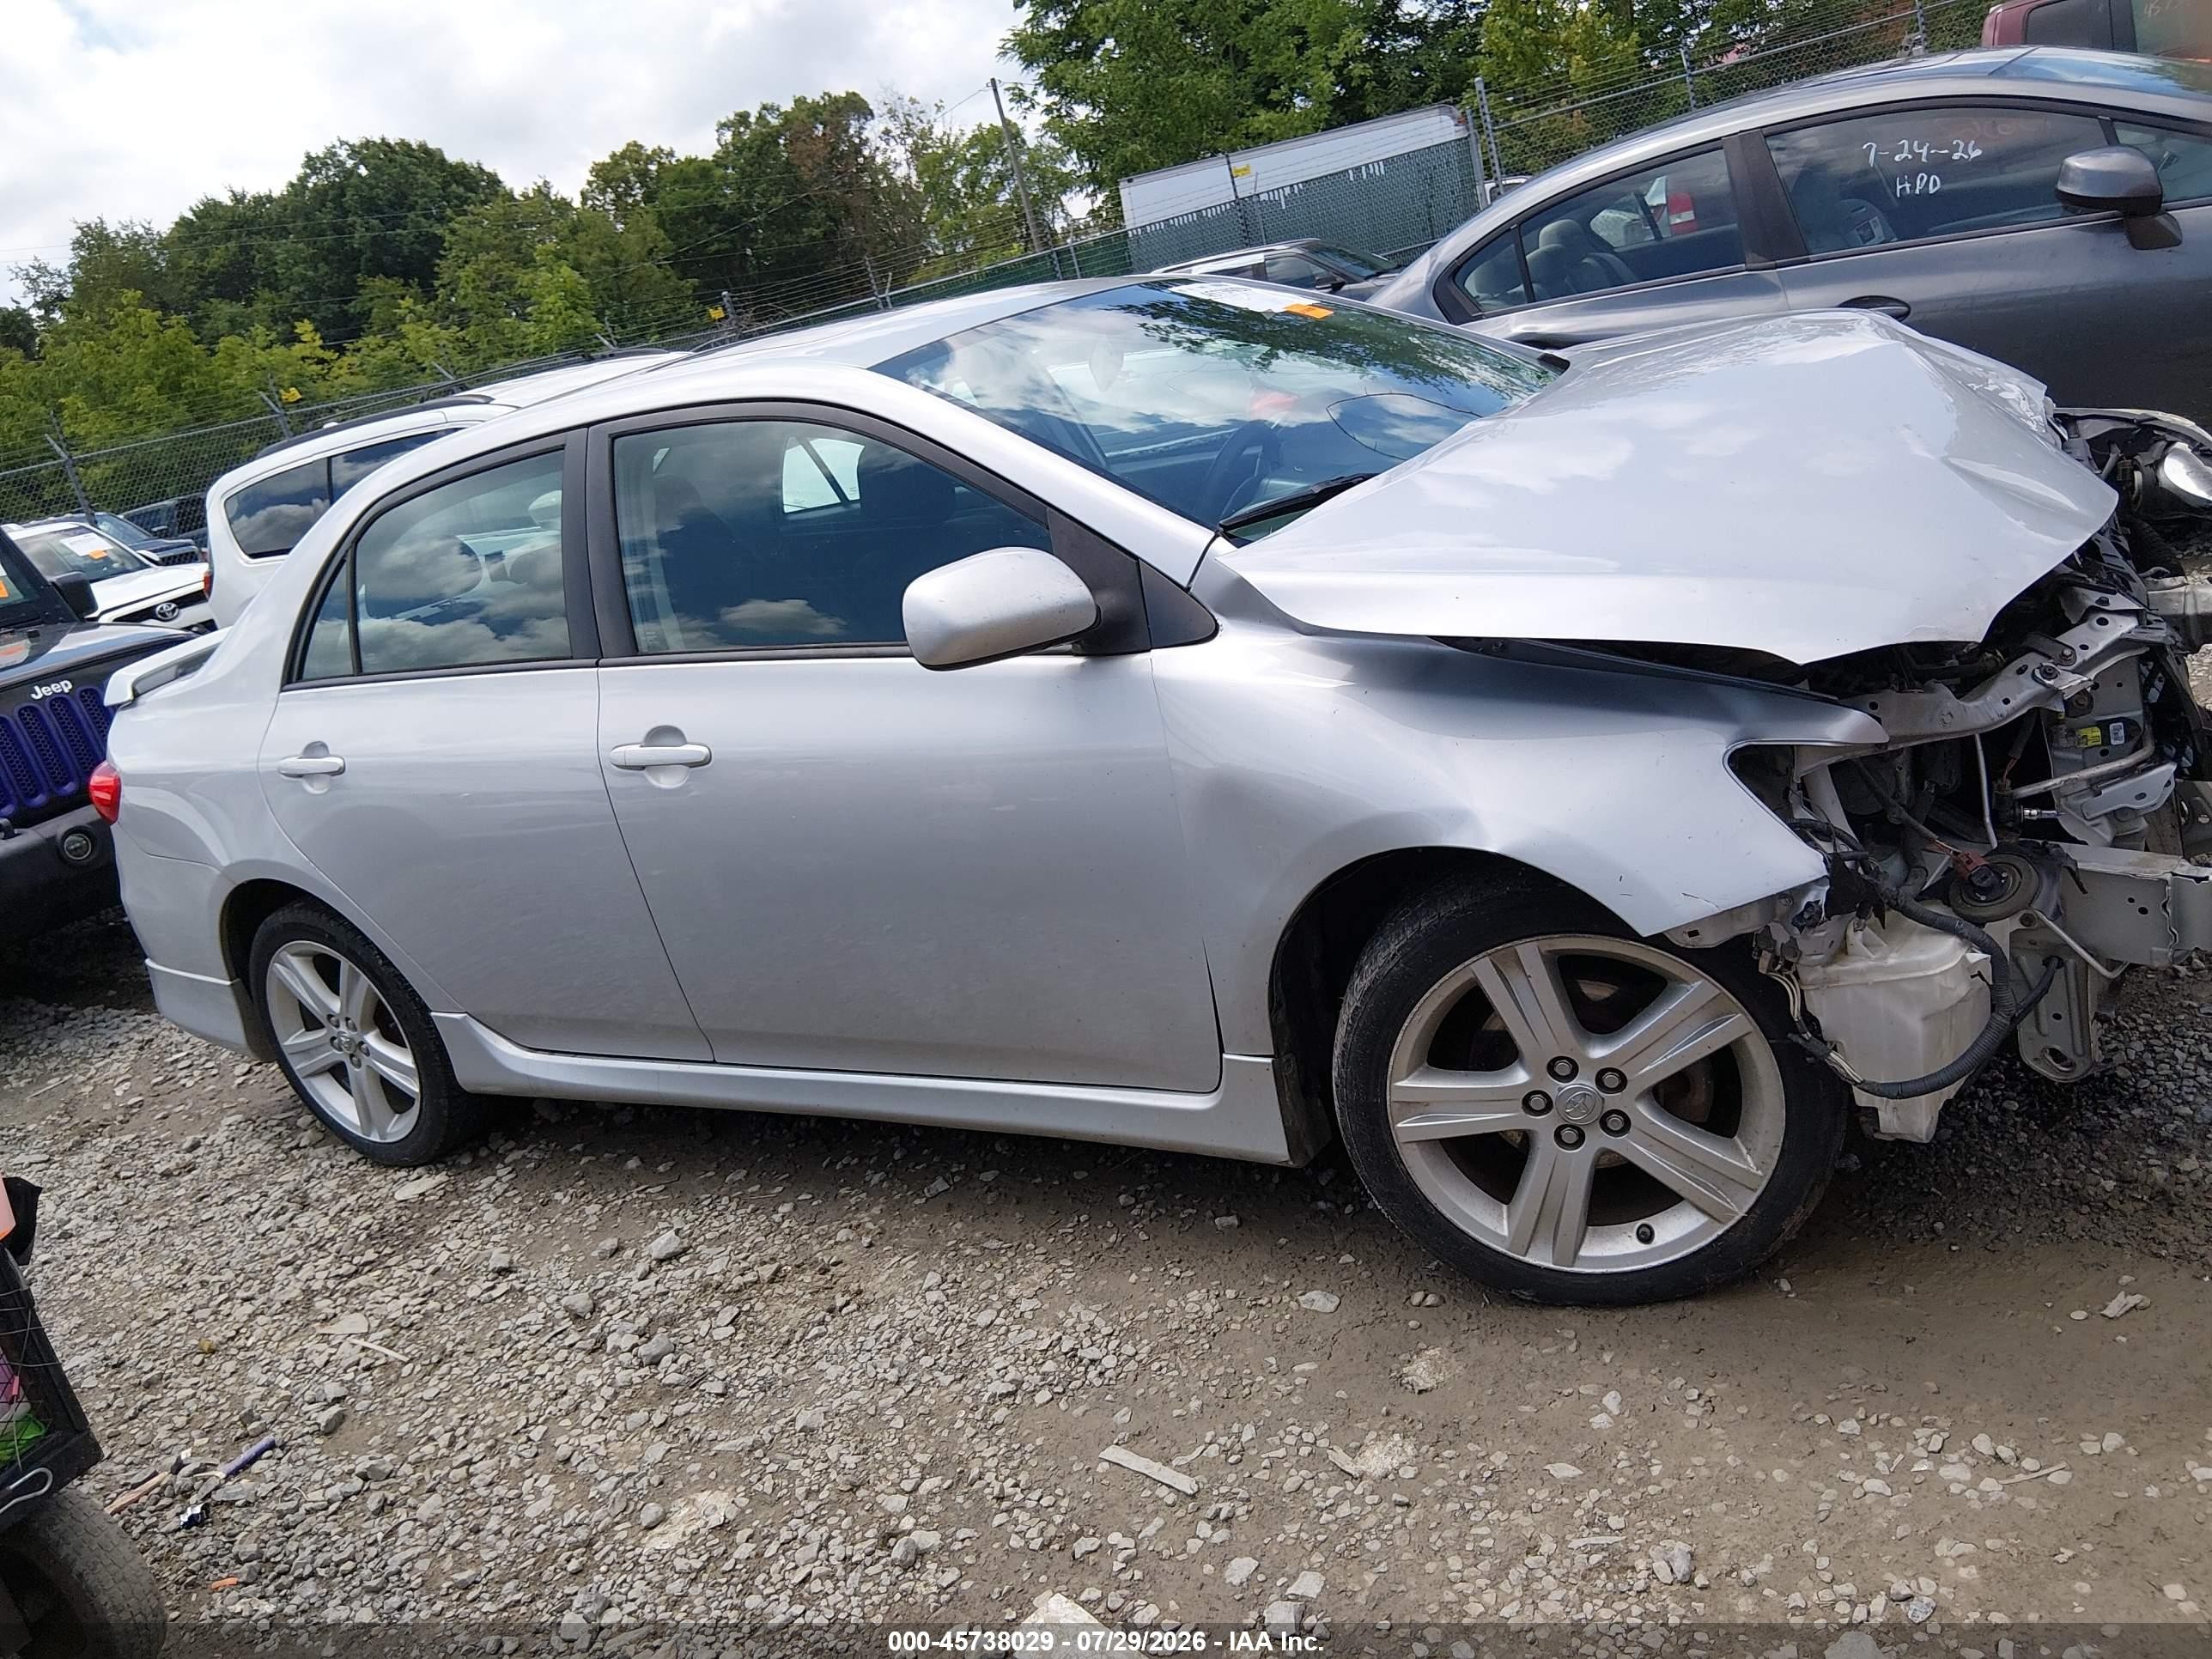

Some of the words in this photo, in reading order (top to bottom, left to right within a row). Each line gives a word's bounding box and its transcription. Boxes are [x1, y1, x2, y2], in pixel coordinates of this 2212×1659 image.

[1862, 139, 1983, 167] 7-24-26
[1896, 173, 1942, 198] HPD
[31, 680, 73, 700] Jeep
